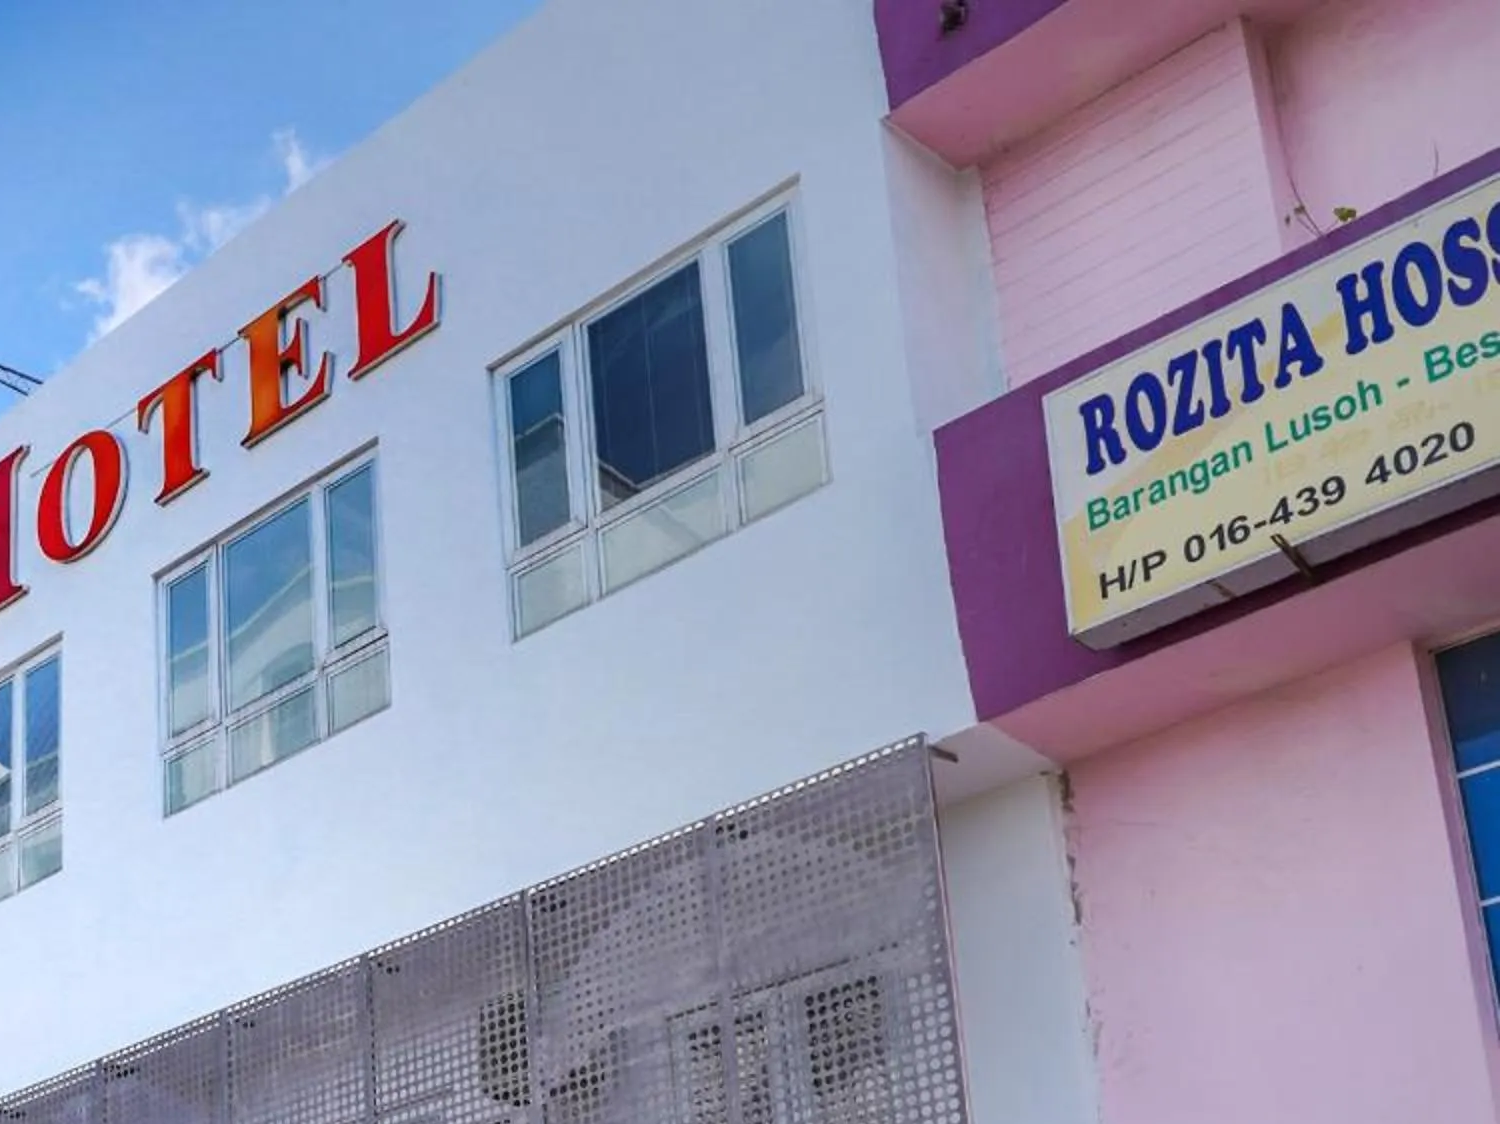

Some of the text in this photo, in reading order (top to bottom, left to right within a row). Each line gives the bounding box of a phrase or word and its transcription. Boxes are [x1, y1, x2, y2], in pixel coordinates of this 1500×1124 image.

[1079, 302, 1324, 475] ROZITA
[1335, 200, 1500, 356] HOS
[1087, 440, 1253, 531] Barangan
[1264, 379, 1383, 455] Lusoh
[1099, 549, 1168, 598] H/P
[1184, 476, 1346, 562] 016-439
[1365, 421, 1476, 485] 4020
